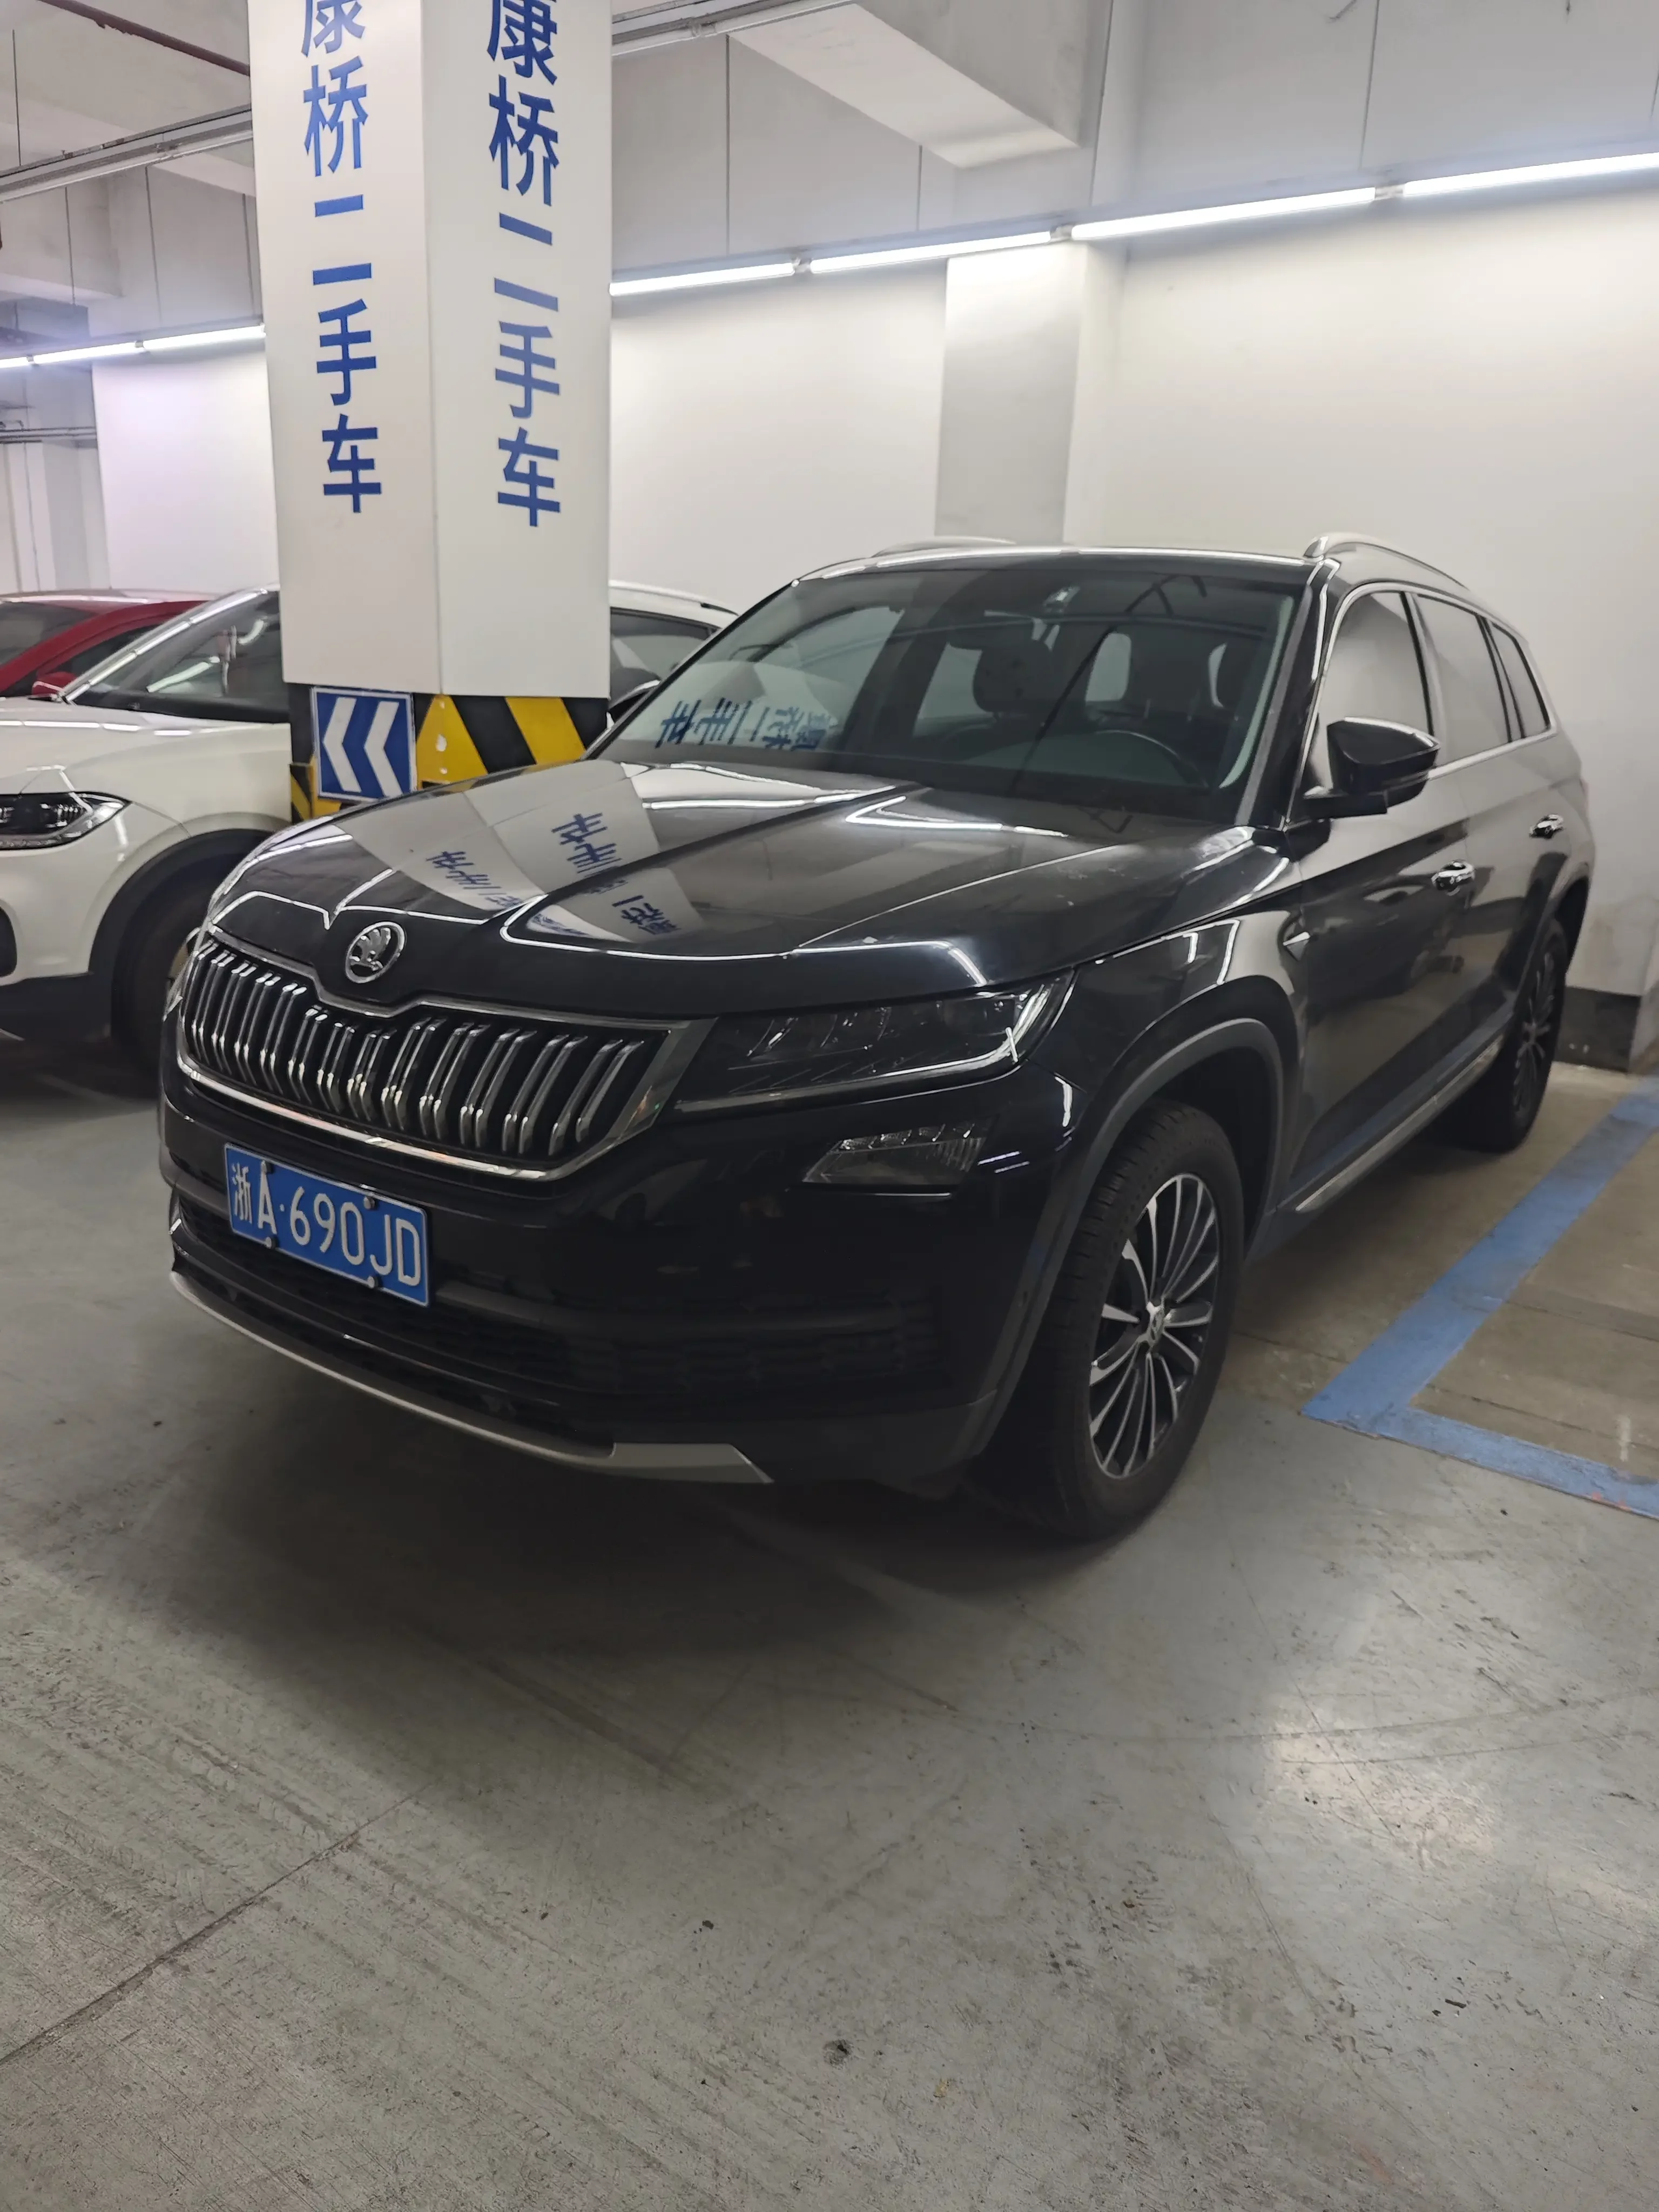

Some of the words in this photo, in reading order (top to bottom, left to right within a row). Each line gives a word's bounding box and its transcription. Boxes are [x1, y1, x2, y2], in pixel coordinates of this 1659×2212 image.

[487, 0, 561, 527] 康桥二手车
[232, 1160, 421, 1286] 浙A·690JD
